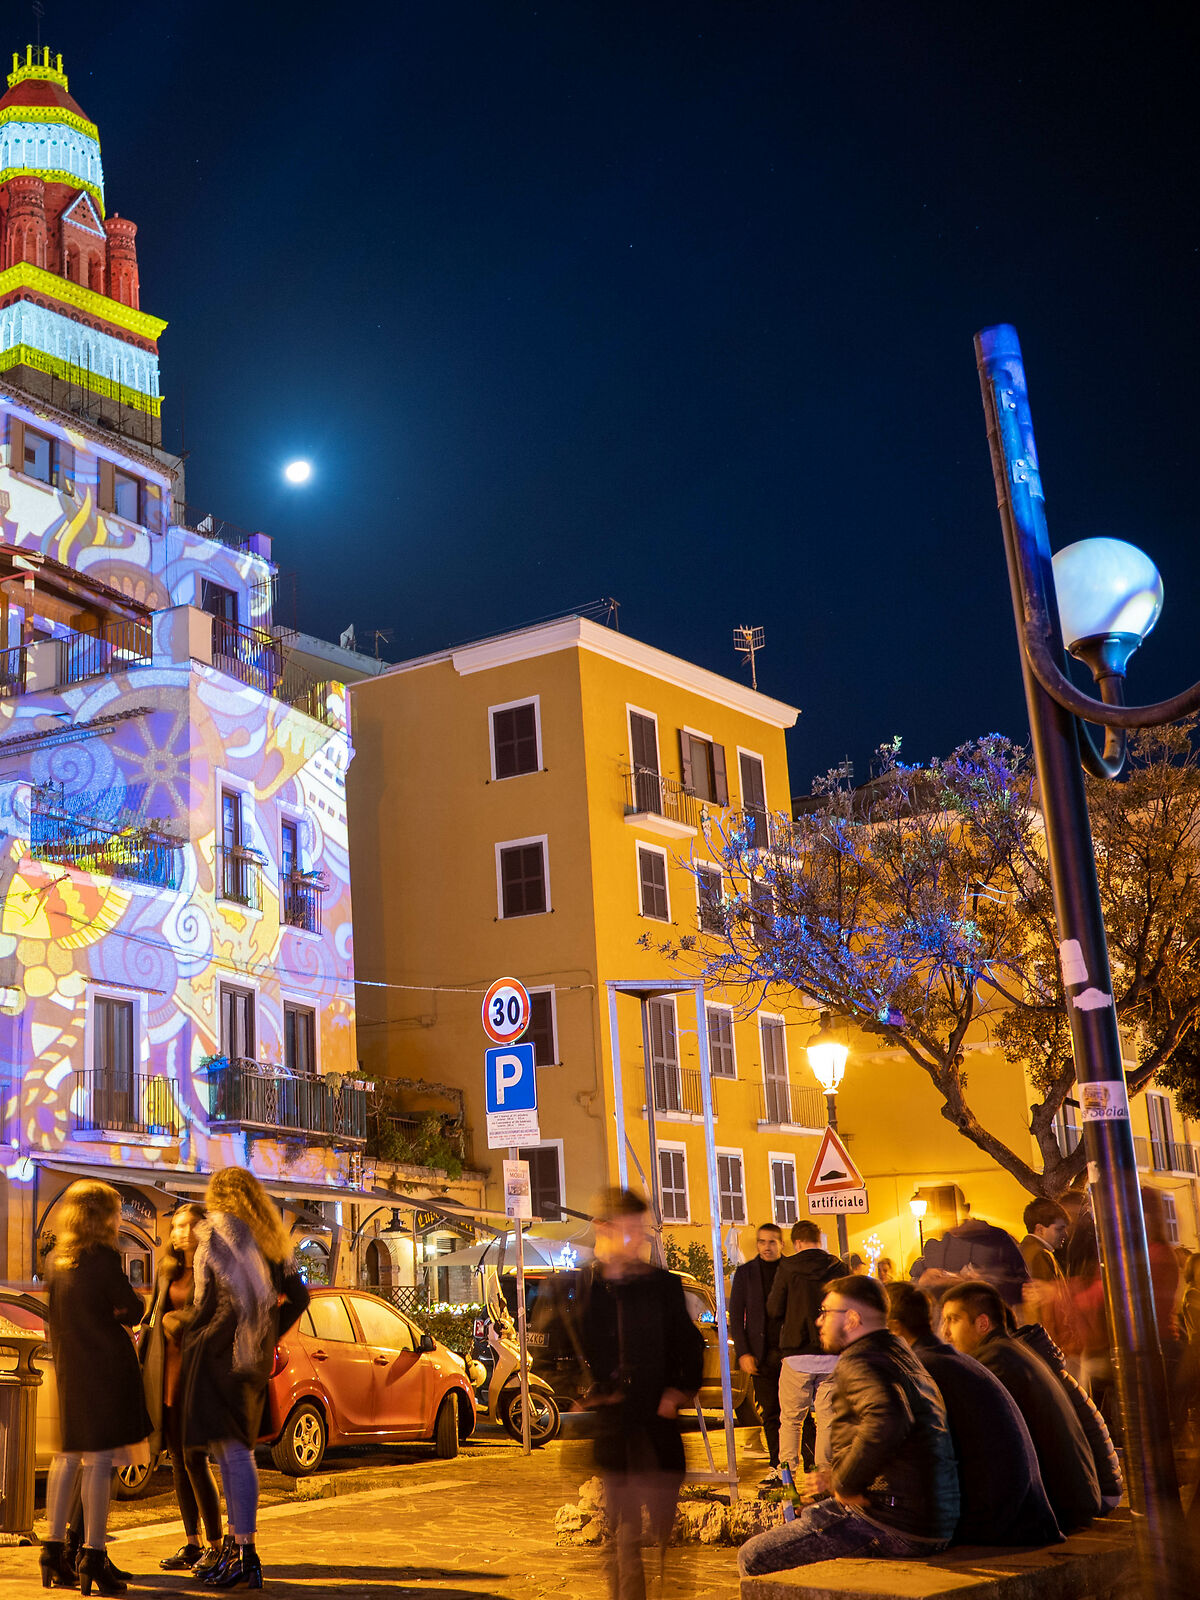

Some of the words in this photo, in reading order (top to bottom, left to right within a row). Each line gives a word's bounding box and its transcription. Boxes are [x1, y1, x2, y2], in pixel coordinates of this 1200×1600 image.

[492, 995, 520, 1026] 30
[495, 1054, 523, 1105] P
[811, 1195, 864, 1208] artificiale
